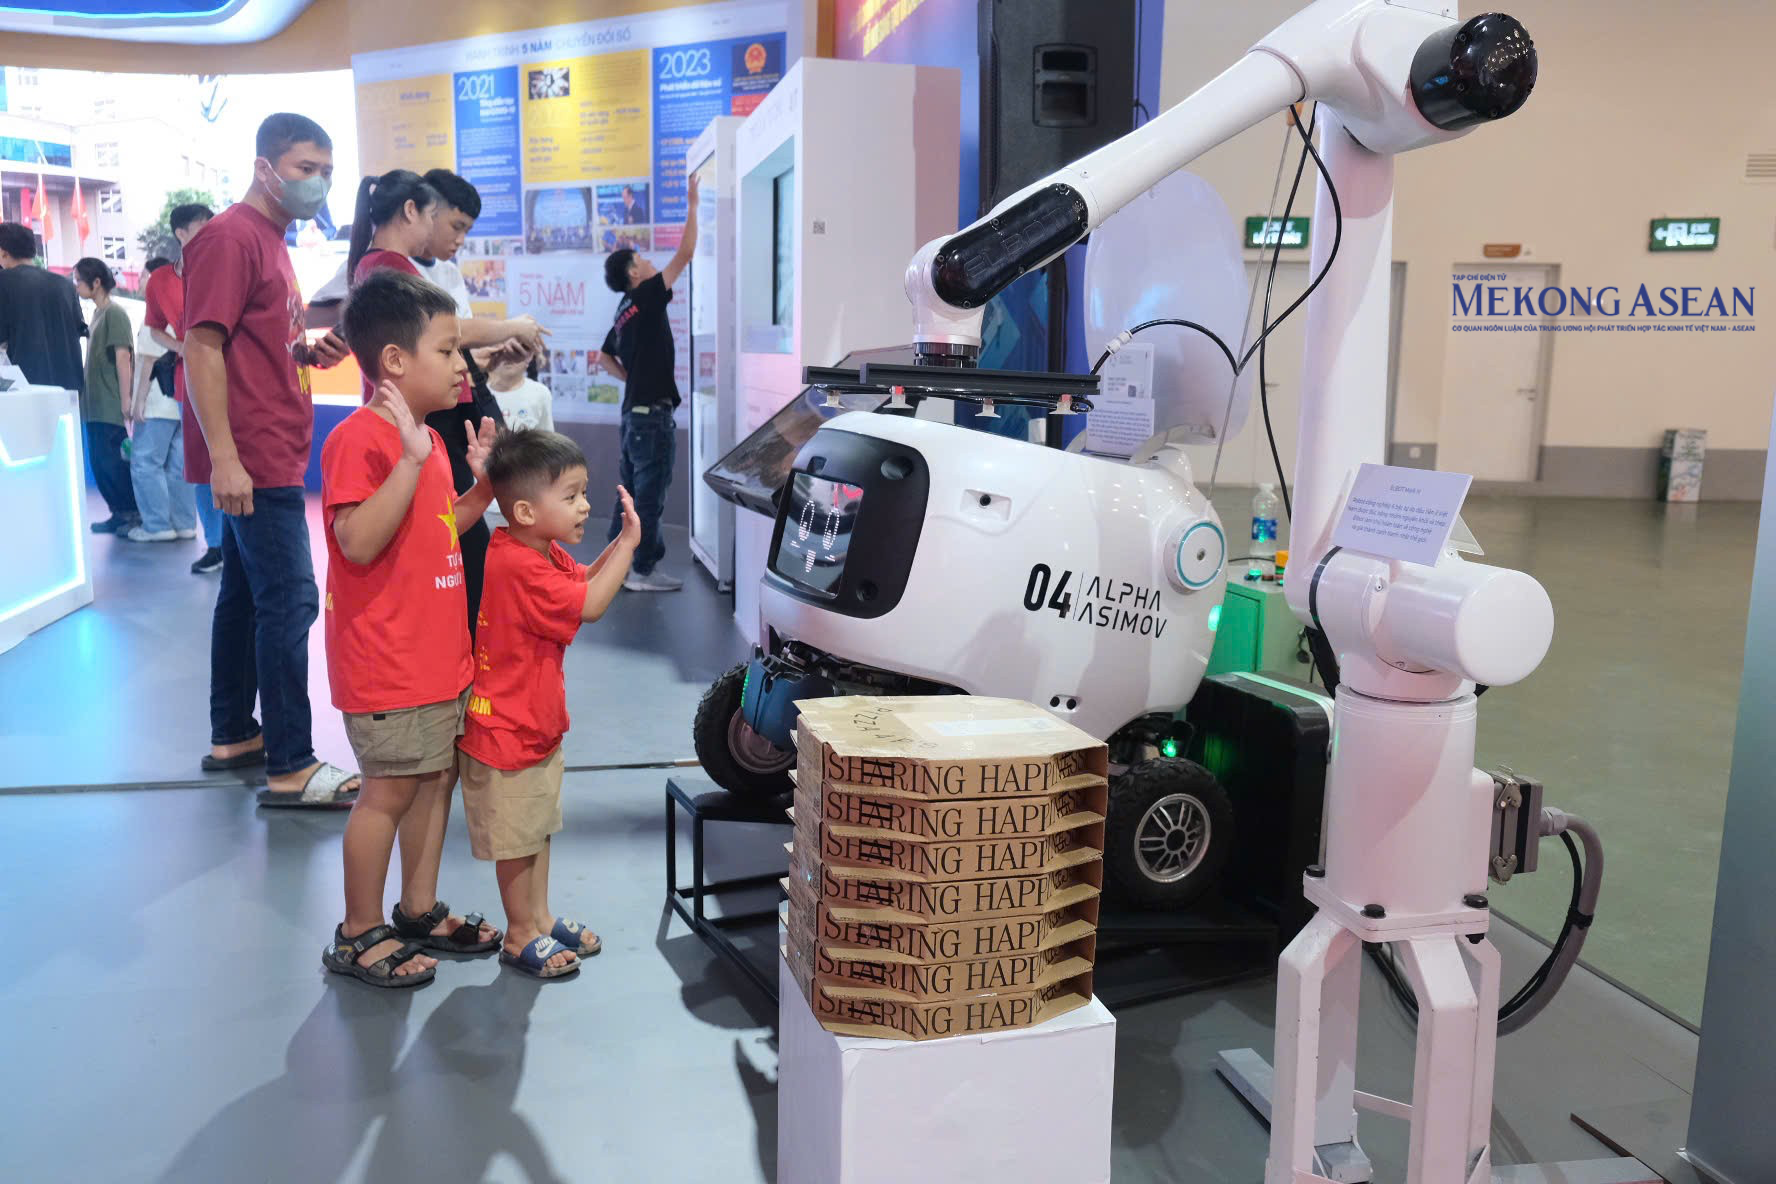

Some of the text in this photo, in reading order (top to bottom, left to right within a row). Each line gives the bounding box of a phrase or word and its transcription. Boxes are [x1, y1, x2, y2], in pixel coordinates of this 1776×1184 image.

[522, 45, 528, 54] 5
[659, 48, 711, 79] 2023
[458, 74, 495, 100] 2021
[519, 281, 532, 307] 5
[1024, 563, 1072, 619] 04
[1086, 576, 1161, 612] ALPHA
[1078, 602, 1168, 639] ASIMOV
[828, 752, 966, 795] SHARING
[826, 791, 964, 838] SHARING
[826, 832, 963, 875] SHARING
[824, 870, 962, 916] SHARING
[824, 912, 962, 960] SHARING
[818, 946, 954, 995] SHARING
[819, 988, 954, 1036] SHARING
